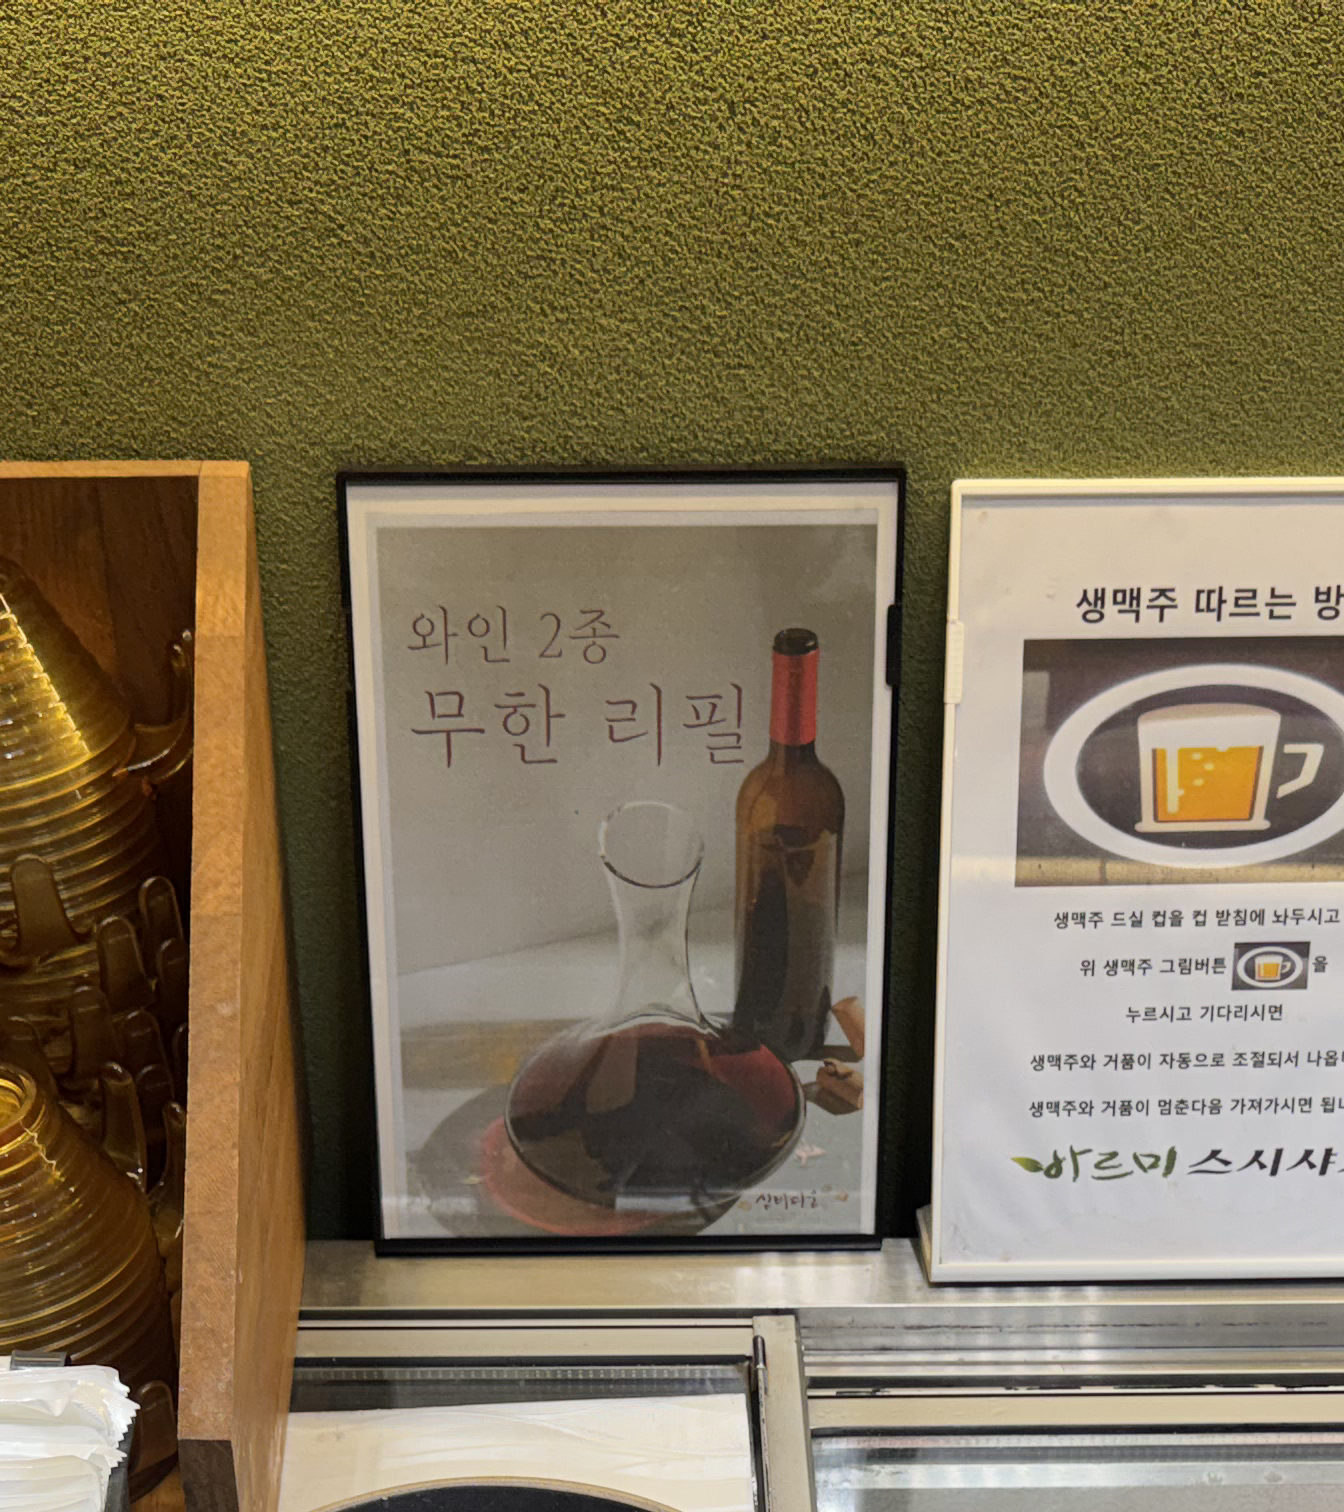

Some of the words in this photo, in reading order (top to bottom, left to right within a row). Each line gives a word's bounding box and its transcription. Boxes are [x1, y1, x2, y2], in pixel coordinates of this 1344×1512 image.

[1076, 586, 1179, 625] 생맥주
[1194, 585, 1297, 623] 따르는
[407, 606, 511, 665] 와인
[538, 608, 620, 666] 2종
[411, 684, 565, 769] 무한
[605, 682, 747, 768] 리필
[1053, 911, 1105, 930] 생맥주
[1110, 910, 1144, 929] 드실
[1151, 909, 1184, 928] 컵을
[1192, 909, 1208, 928] 컵
[1215, 908, 1266, 927] 받침에
[1271, 907, 1341, 926] 놔두시고
[1079, 959, 1096, 977] 위
[1103, 958, 1153, 977] 생맥주
[1159, 957, 1227, 976] 그림버튼
[1312, 955, 1329, 973] 을
[1125, 1005, 1193, 1023] 누르시고
[1199, 1003, 1283, 1023] 기다리시면
[1030, 1053, 1097, 1072] 생맥주와
[1103, 1052, 1152, 1071] 거품이
[1159, 1052, 1226, 1070] 자동으로
[1231, 1050, 1300, 1069] 조절되서
[1028, 1099, 1095, 1119] 생맥주와
[1100, 1098, 1150, 1118] 거품이
[1157, 1097, 1223, 1116] 멈춘다음
[1230, 1096, 1313, 1115] 가져가시면
[1012, 1145, 1177, 1182] 바르미
